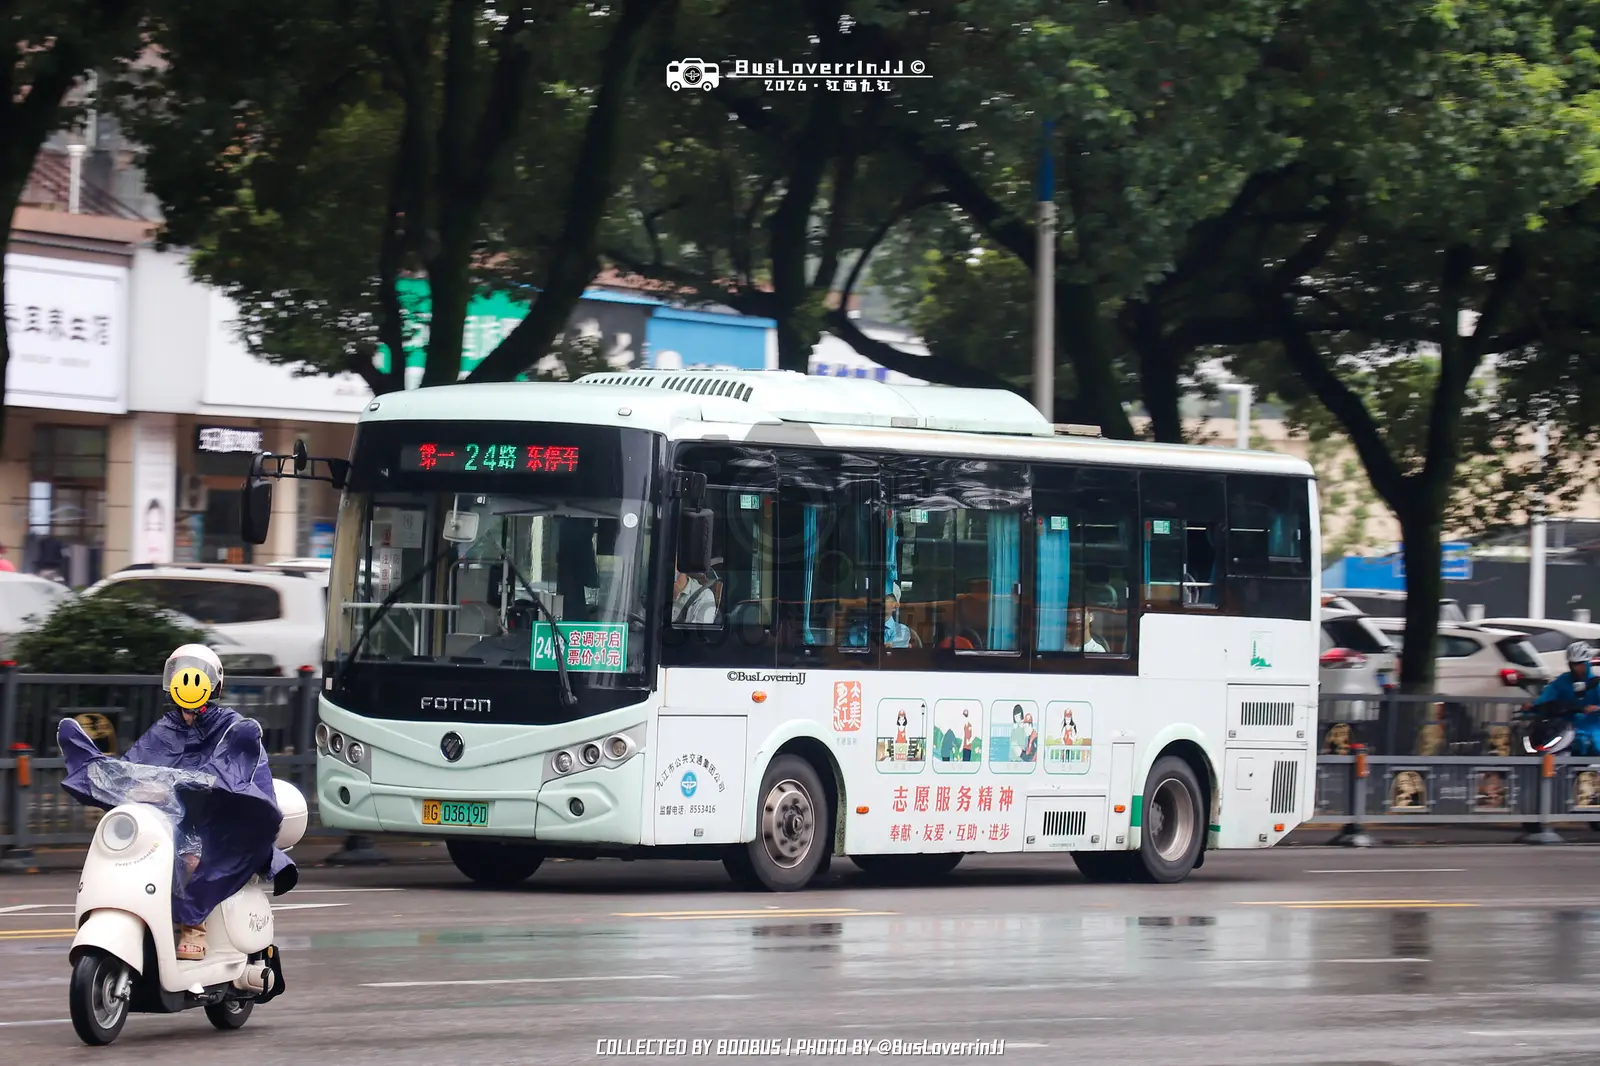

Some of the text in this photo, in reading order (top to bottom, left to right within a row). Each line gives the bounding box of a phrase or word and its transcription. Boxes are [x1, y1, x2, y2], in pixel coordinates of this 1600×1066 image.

[464, 443, 517, 471] 24路
[569, 631, 622, 647] 空调开启
[567, 648, 621, 666] 票价+1元
[656, 753, 726, 793] 九江市公共交通集团公司
[892, 785, 1015, 813] 志愿服务精神
